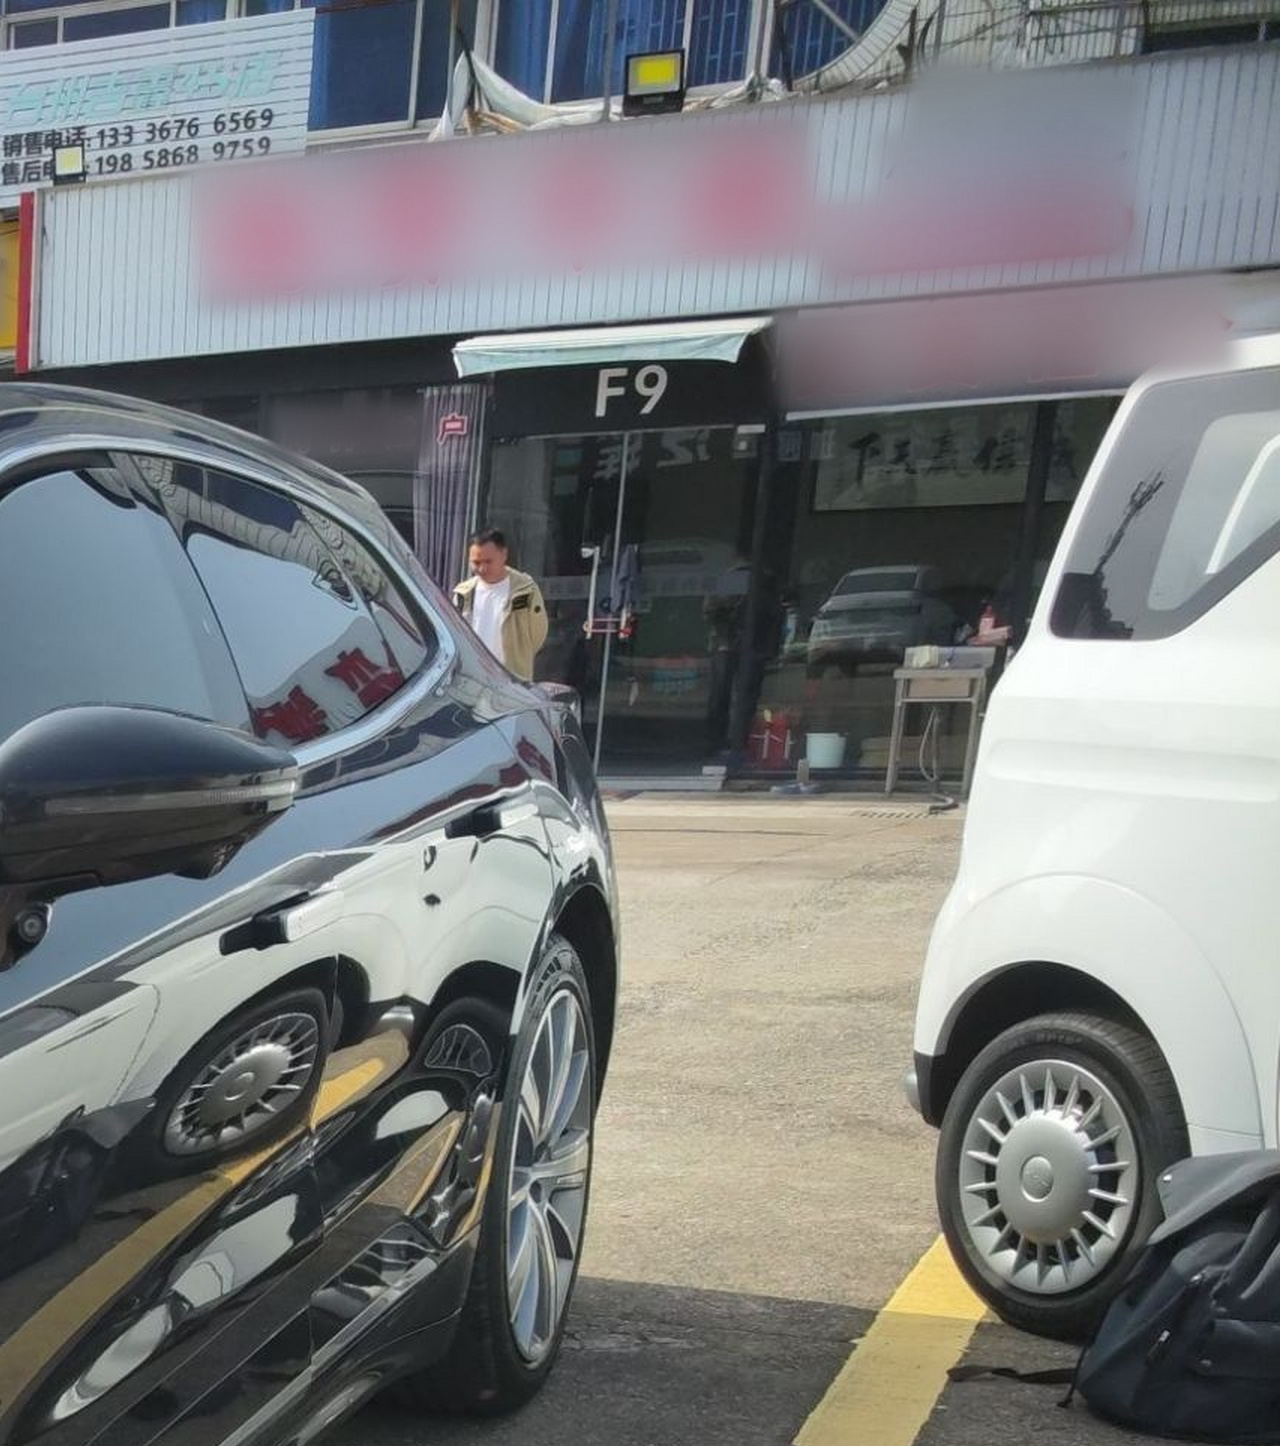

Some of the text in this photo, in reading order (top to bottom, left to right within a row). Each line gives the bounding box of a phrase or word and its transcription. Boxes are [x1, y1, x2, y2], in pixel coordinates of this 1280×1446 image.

[146, 117, 200, 141] 3676
[213, 108, 274, 134] 6569
[143, 144, 199, 169] 5868
[213, 136, 271, 162] 9759
[595, 364, 668, 417] F9
